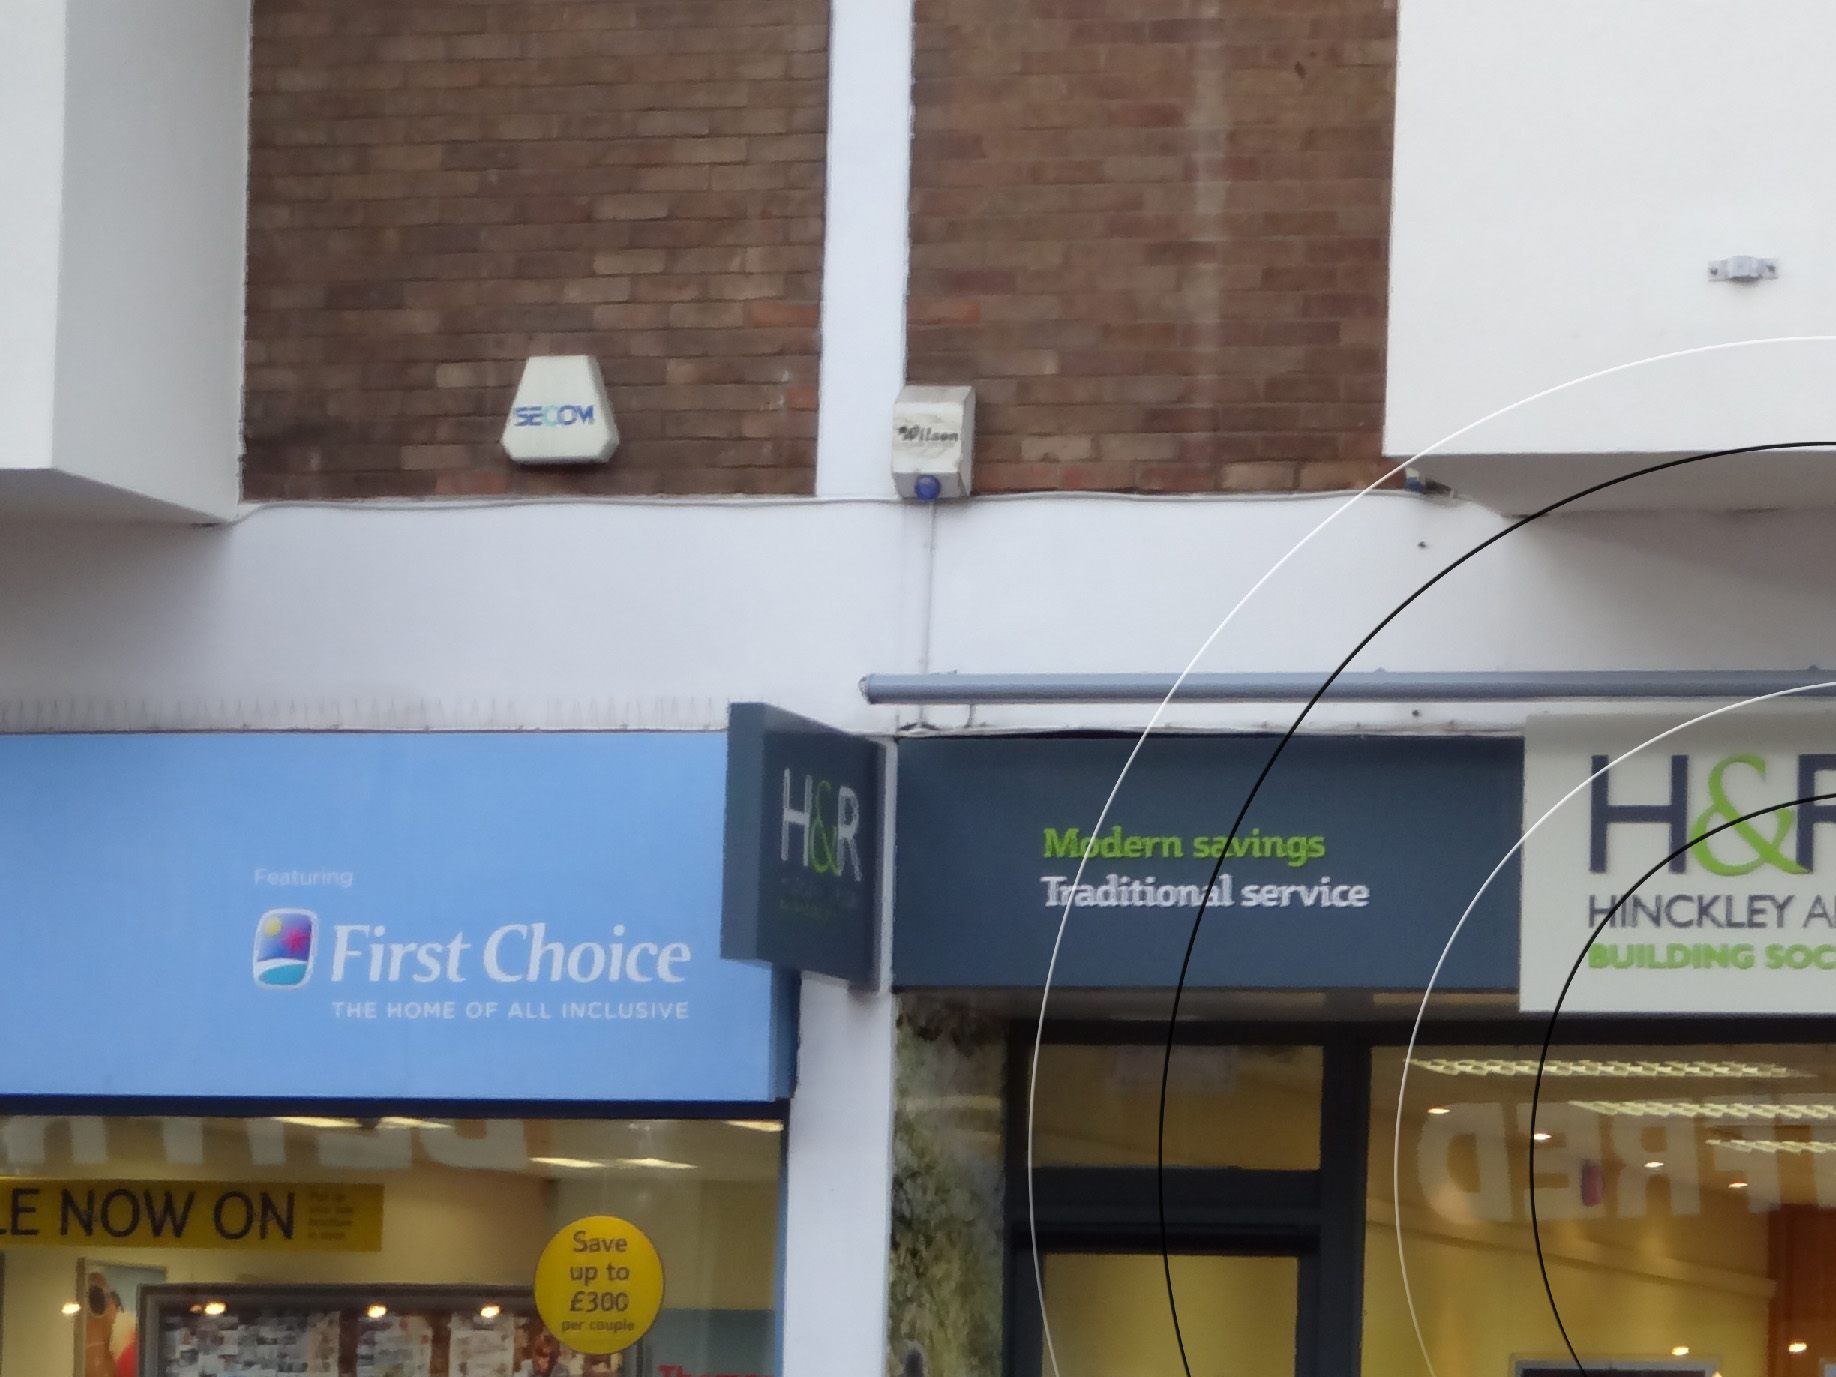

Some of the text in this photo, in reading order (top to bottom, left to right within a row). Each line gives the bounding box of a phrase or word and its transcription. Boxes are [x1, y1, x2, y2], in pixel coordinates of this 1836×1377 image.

[514, 404, 595, 426] SECOM
[781, 768, 862, 881] H&R
[1043, 827, 1326, 867] Modern savings
[254, 868, 353, 888] Featuring
[1040, 874, 1370, 908] Traditional service
[1588, 895, 1796, 930] HINCKLEY
[330, 922, 692, 983] First Choice
[1588, 943, 1756, 970] BUILDING
[333, 1001, 690, 1019] THE HOME OF ALL INCLUSIVE
[60, 1188, 196, 1239] NOW
[213, 1190, 296, 1241] ON
[573, 1230, 627, 1253] Save
[570, 1263, 630, 1286] up to
[569, 1290, 629, 1312] £300
[561, 1319, 635, 1333] per couple
